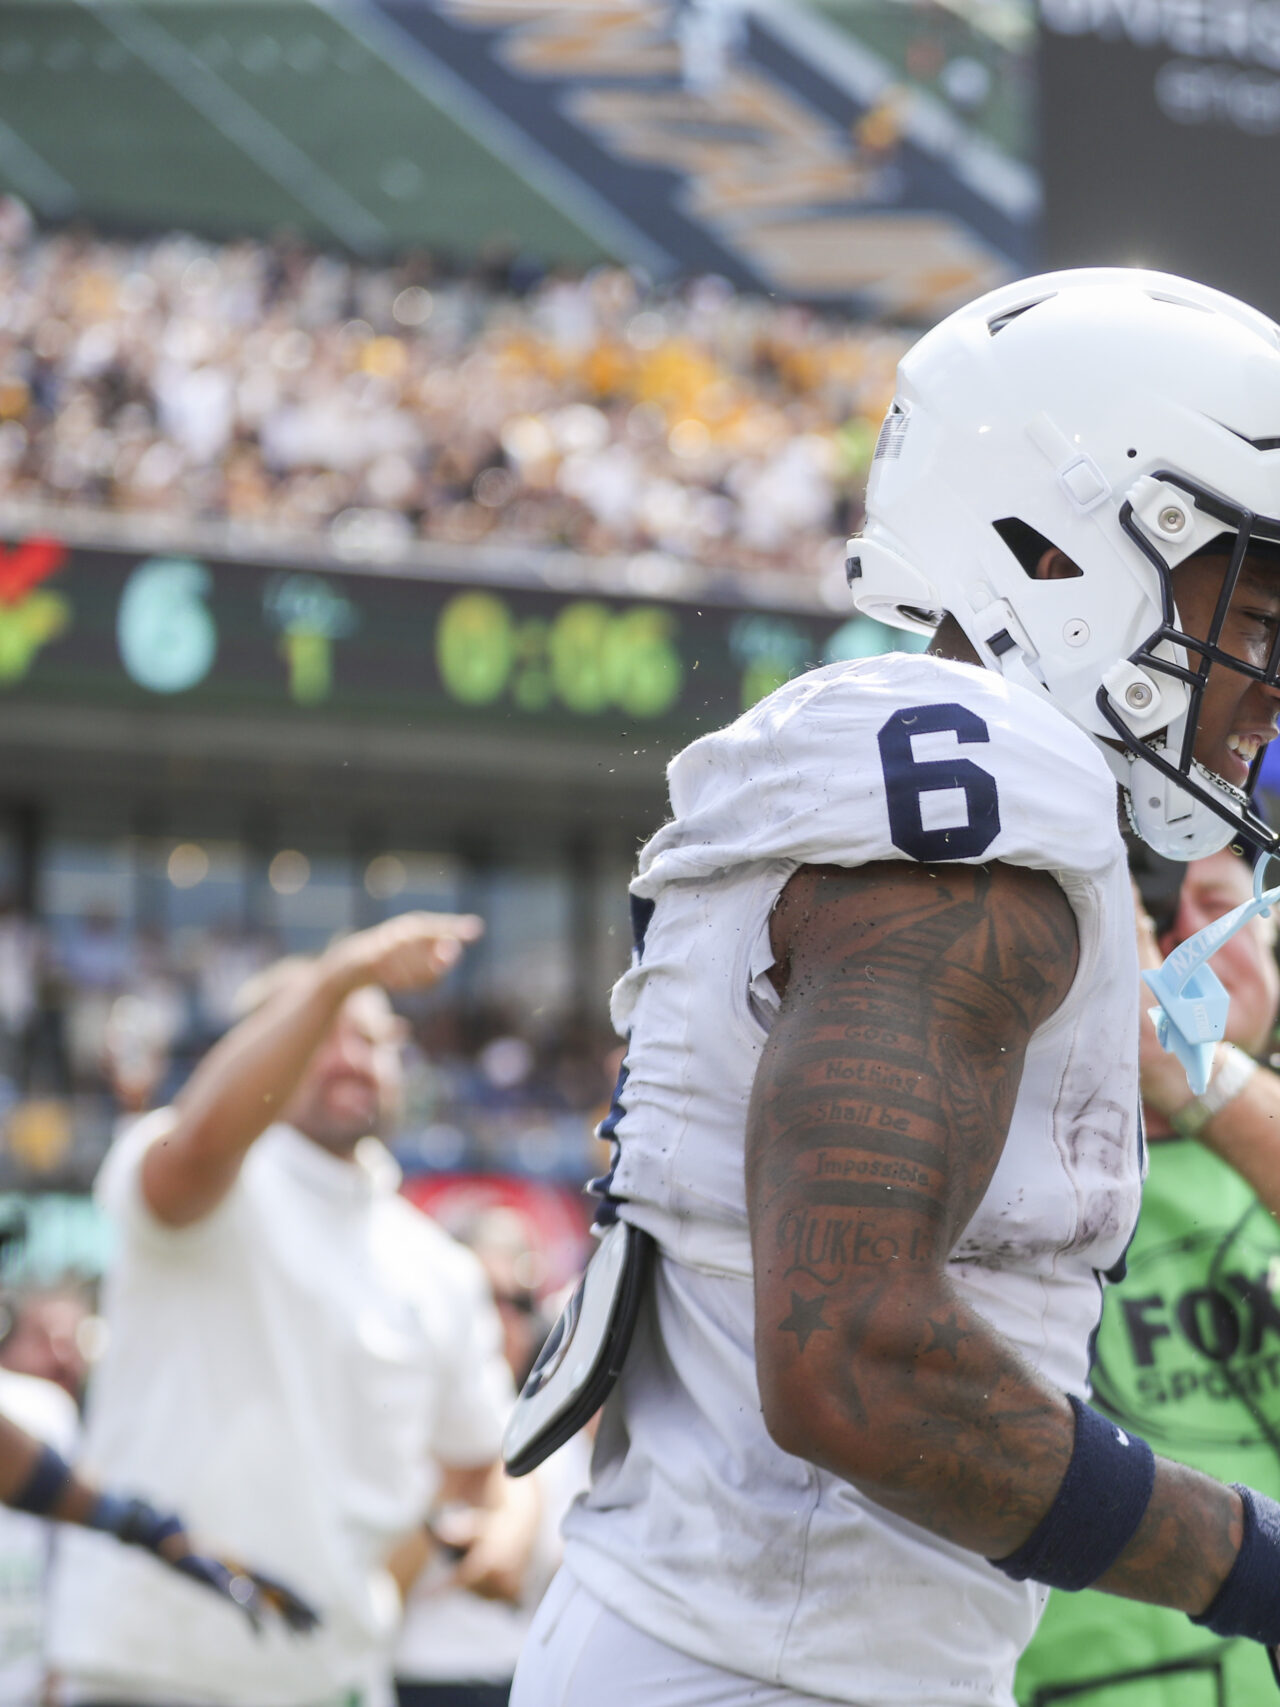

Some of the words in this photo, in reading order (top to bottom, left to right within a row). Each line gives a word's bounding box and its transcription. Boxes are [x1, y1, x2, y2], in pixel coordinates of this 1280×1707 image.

[116, 555, 216, 694] 6
[877, 703, 1001, 862] 6
[826, 1060, 919, 1092] Nothing
[879, 1106, 912, 1132] be
[815, 1151, 930, 1187] Impossible
